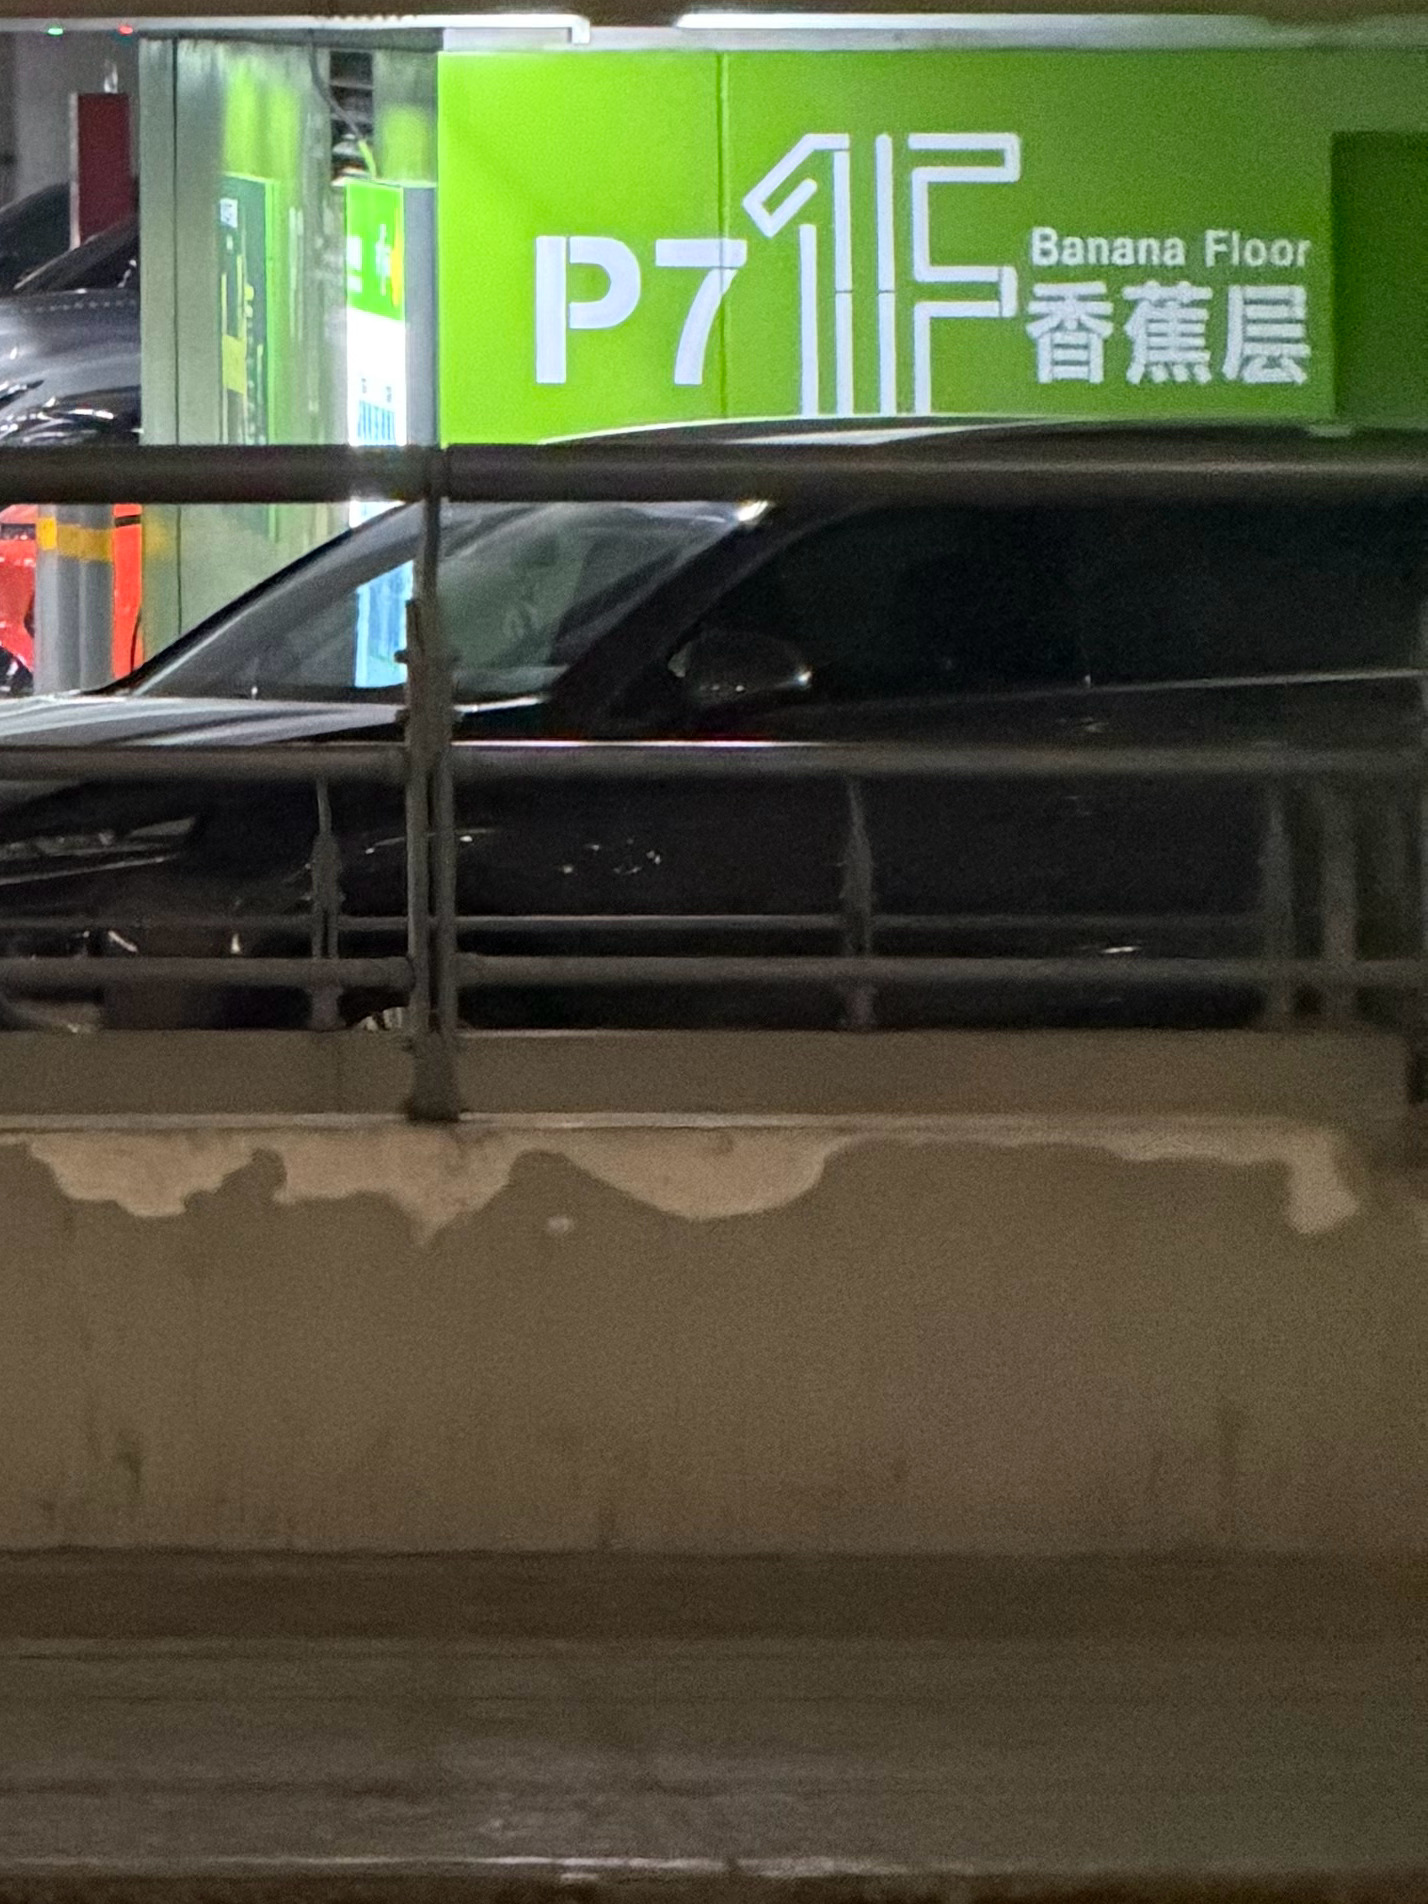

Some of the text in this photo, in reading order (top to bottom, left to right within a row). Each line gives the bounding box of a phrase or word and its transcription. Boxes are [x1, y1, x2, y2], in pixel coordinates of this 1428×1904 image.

[1031, 226, 1312, 269] Banana Floor
[534, 234, 749, 386] P7
[1025, 281, 1312, 387] 香蕉层
